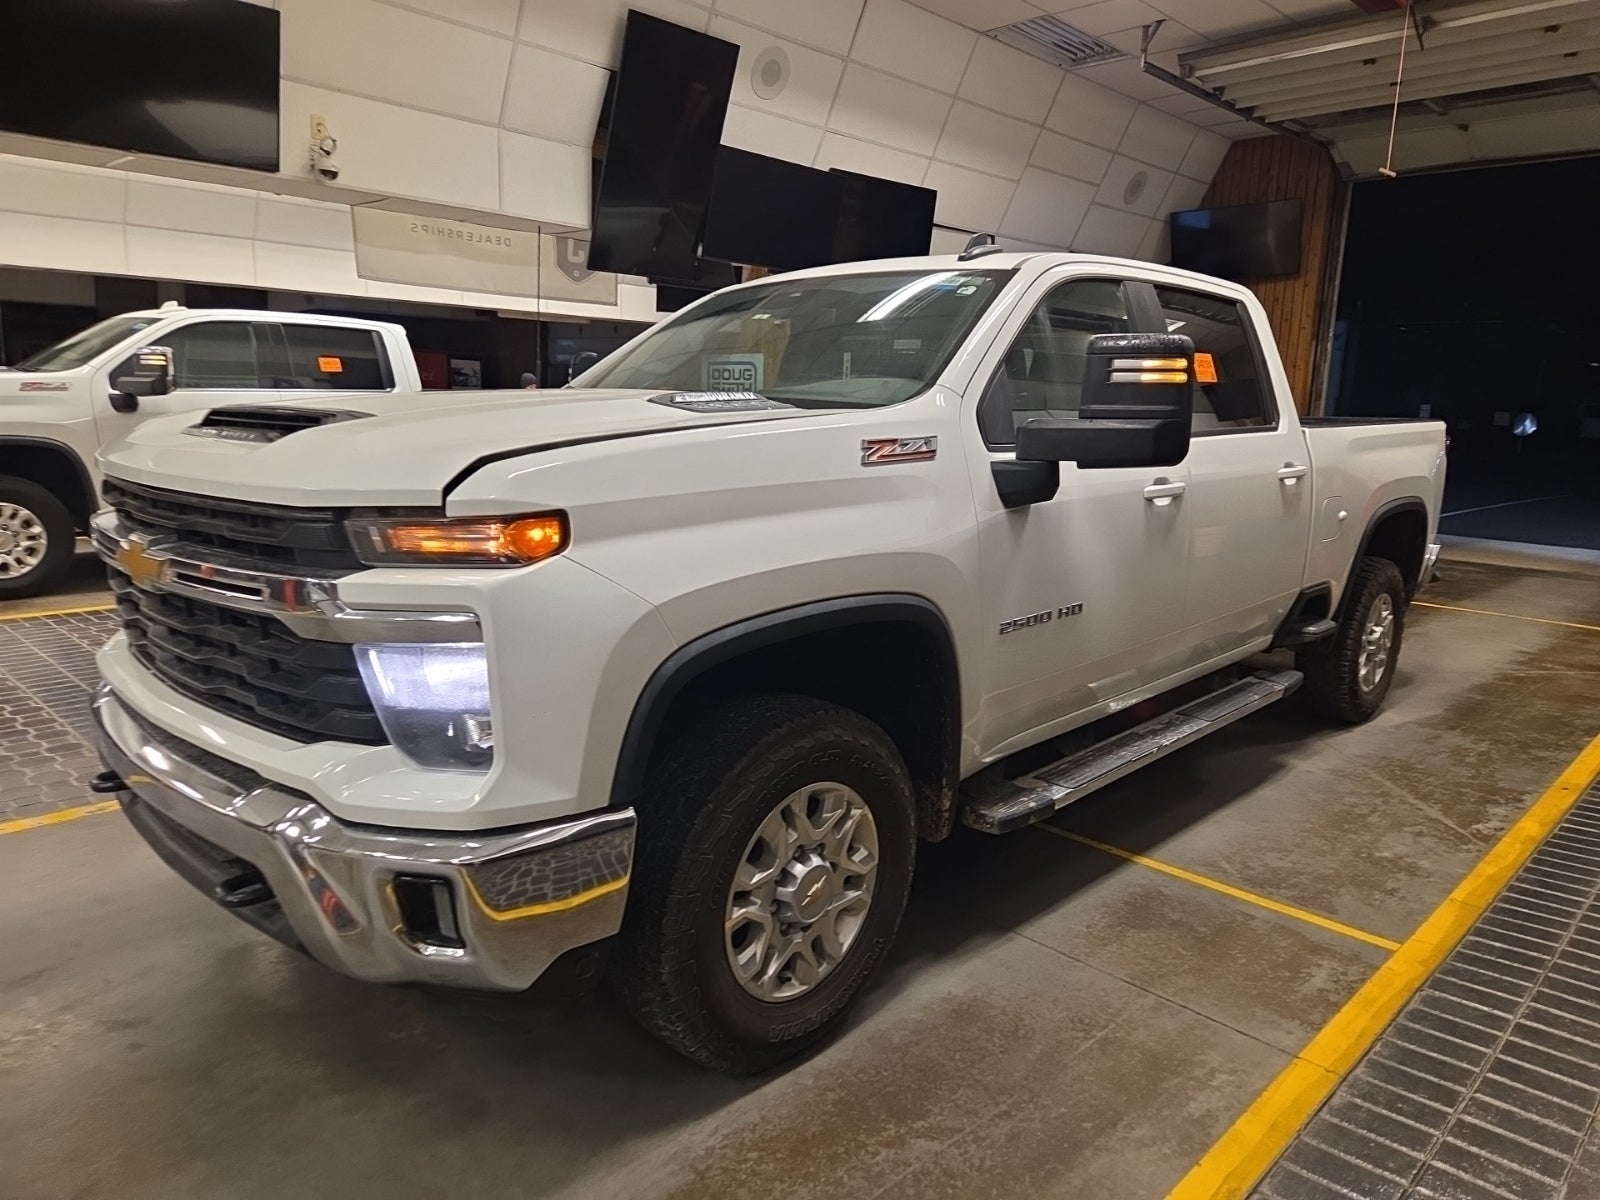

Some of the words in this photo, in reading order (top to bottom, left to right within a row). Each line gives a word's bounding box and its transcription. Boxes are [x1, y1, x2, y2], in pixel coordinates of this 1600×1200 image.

[711, 368, 753, 381] DOUG
[860, 435, 938, 467] Z71
[999, 609, 1053, 635] 2500
[1057, 601, 1084, 620] HD
